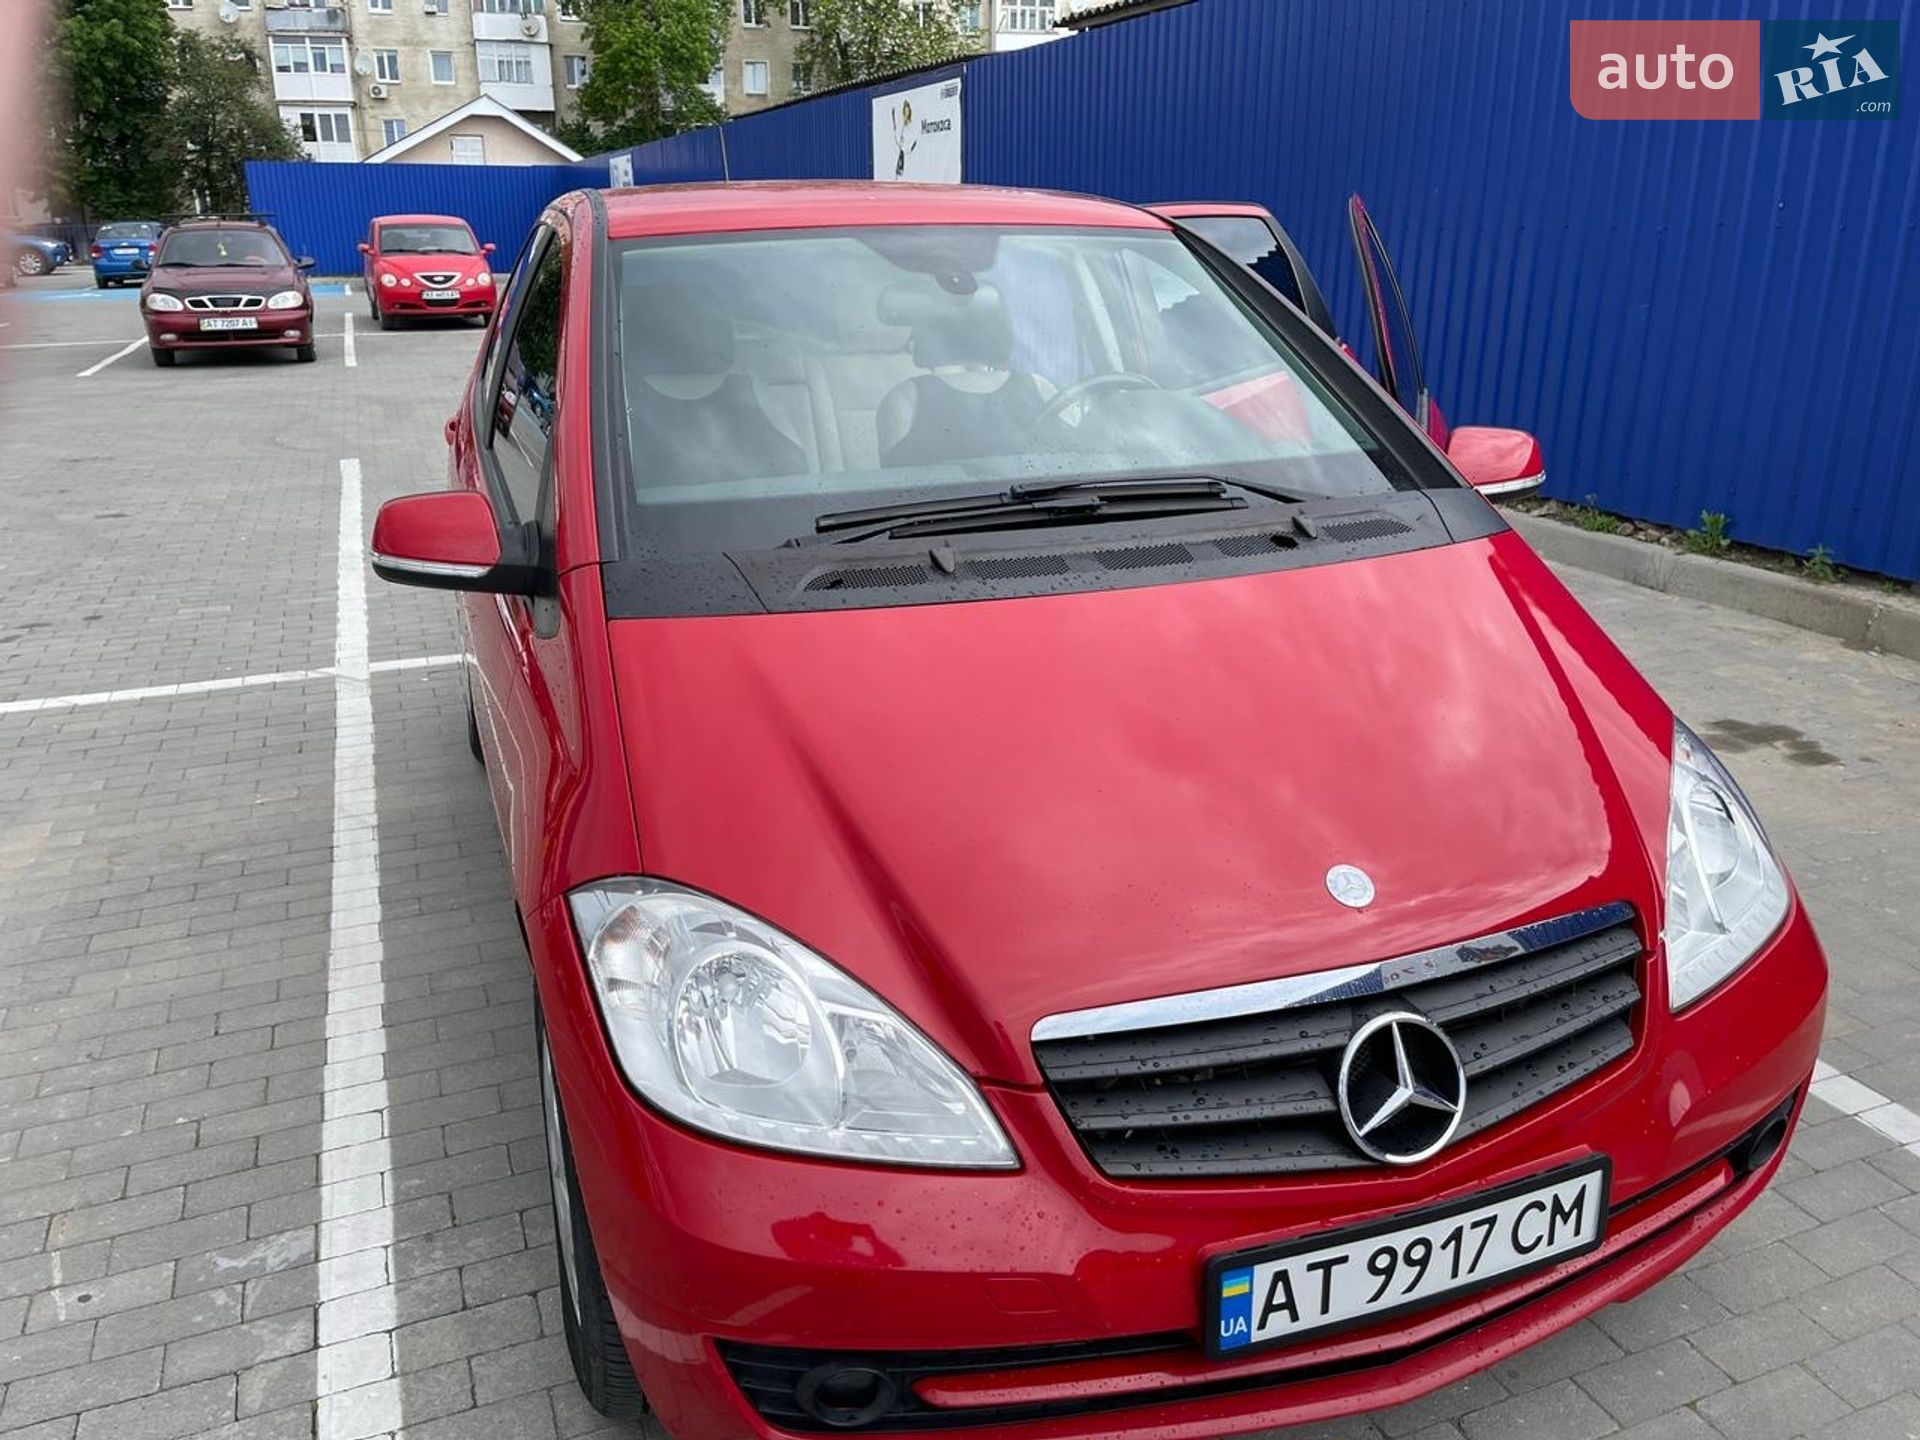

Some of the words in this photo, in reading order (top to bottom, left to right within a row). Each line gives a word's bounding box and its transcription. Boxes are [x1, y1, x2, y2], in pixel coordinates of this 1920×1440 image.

[1256, 1255, 1349, 1331] AT
[1366, 1214, 1498, 1304] 9917
[1511, 1184, 1587, 1255] CM
[1220, 1316, 1248, 1337] UA
